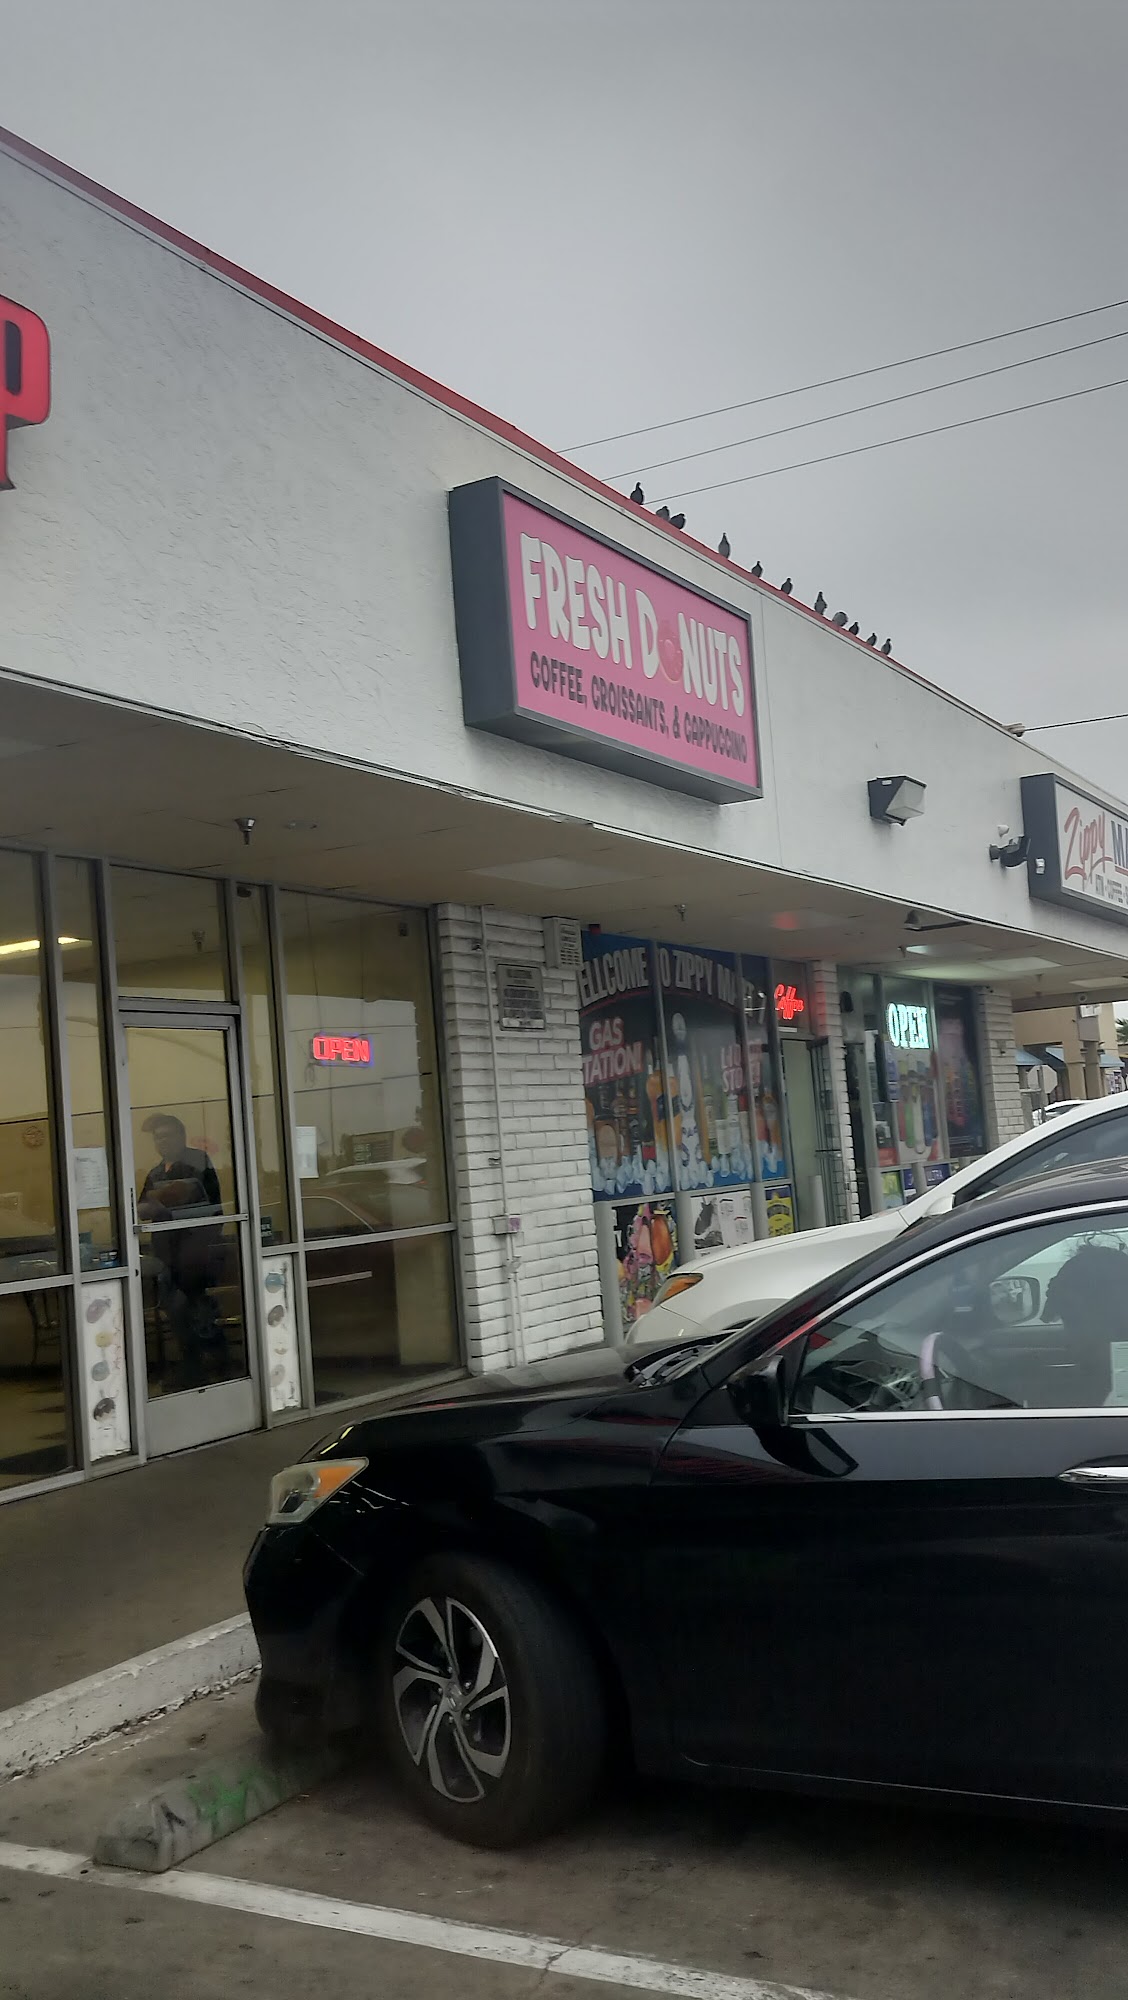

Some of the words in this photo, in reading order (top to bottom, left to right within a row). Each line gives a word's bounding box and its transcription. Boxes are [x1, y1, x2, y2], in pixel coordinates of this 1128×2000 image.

[520, 532, 633, 670] FRESH
[635, 588, 745, 717] DONUTS
[530, 651, 587, 709] COFFEE,
[591, 675, 669, 739] CROISSANTS,
[673, 705, 681, 739] &
[684, 712, 748, 764] CAPPUCCINO
[1064, 807, 1113, 892] Zippy
[577, 947, 649, 1007] ELLCOME
[672, 950, 714, 995] ZIPPY
[313, 1036, 370, 1063] OPEN
[589, 1016, 624, 1051] GAS
[887, 1002, 930, 1049] OPEN
